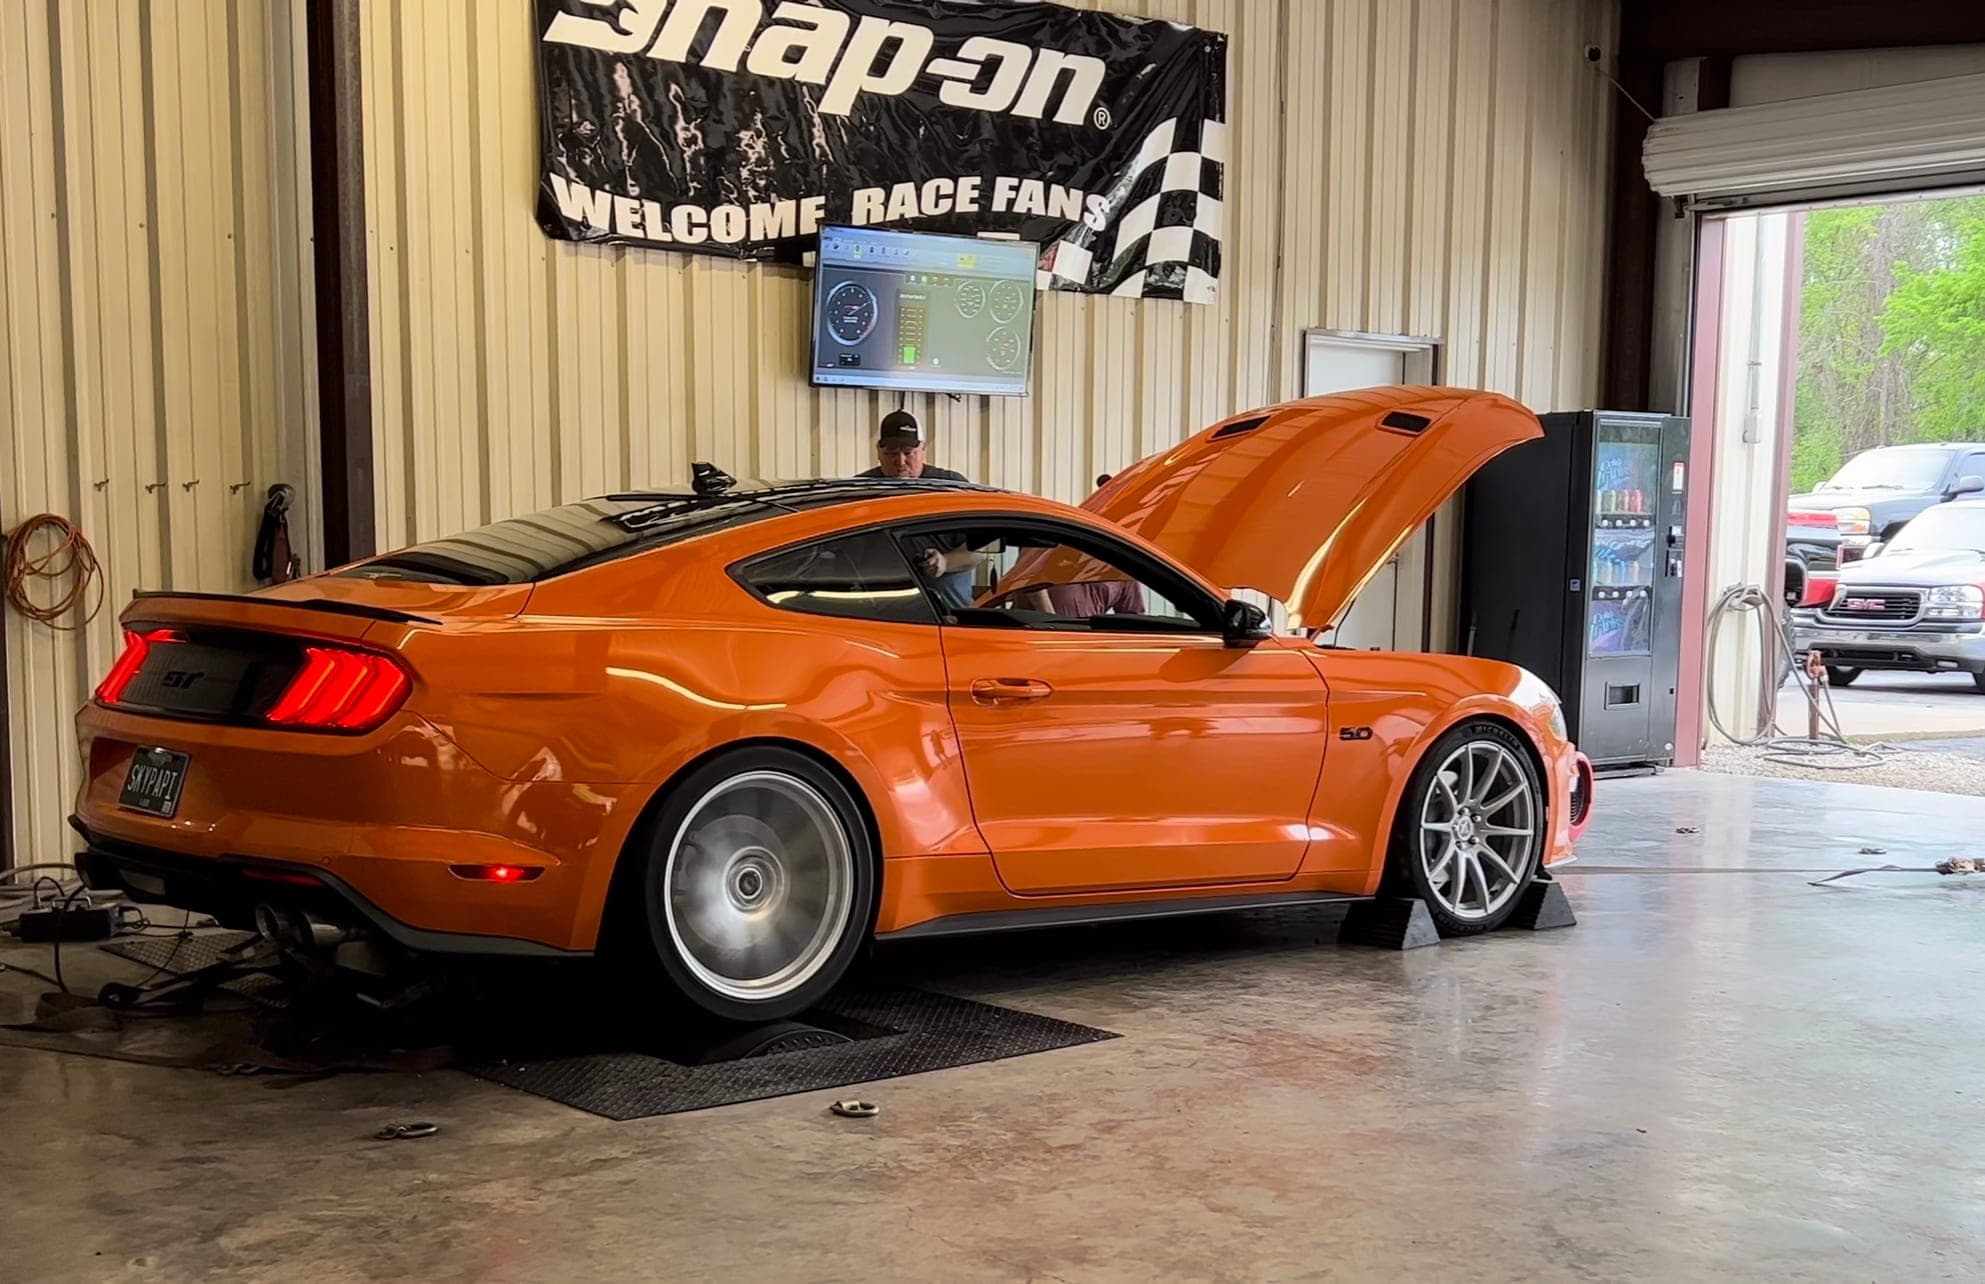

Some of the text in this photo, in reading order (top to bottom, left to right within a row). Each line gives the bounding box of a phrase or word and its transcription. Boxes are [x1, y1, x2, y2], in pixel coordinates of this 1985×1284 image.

[549, 172, 1106, 244] WELCOME RACE FANS
[1847, 598, 1885, 610] GMC
[127, 764, 178, 800] SKYPAPI
